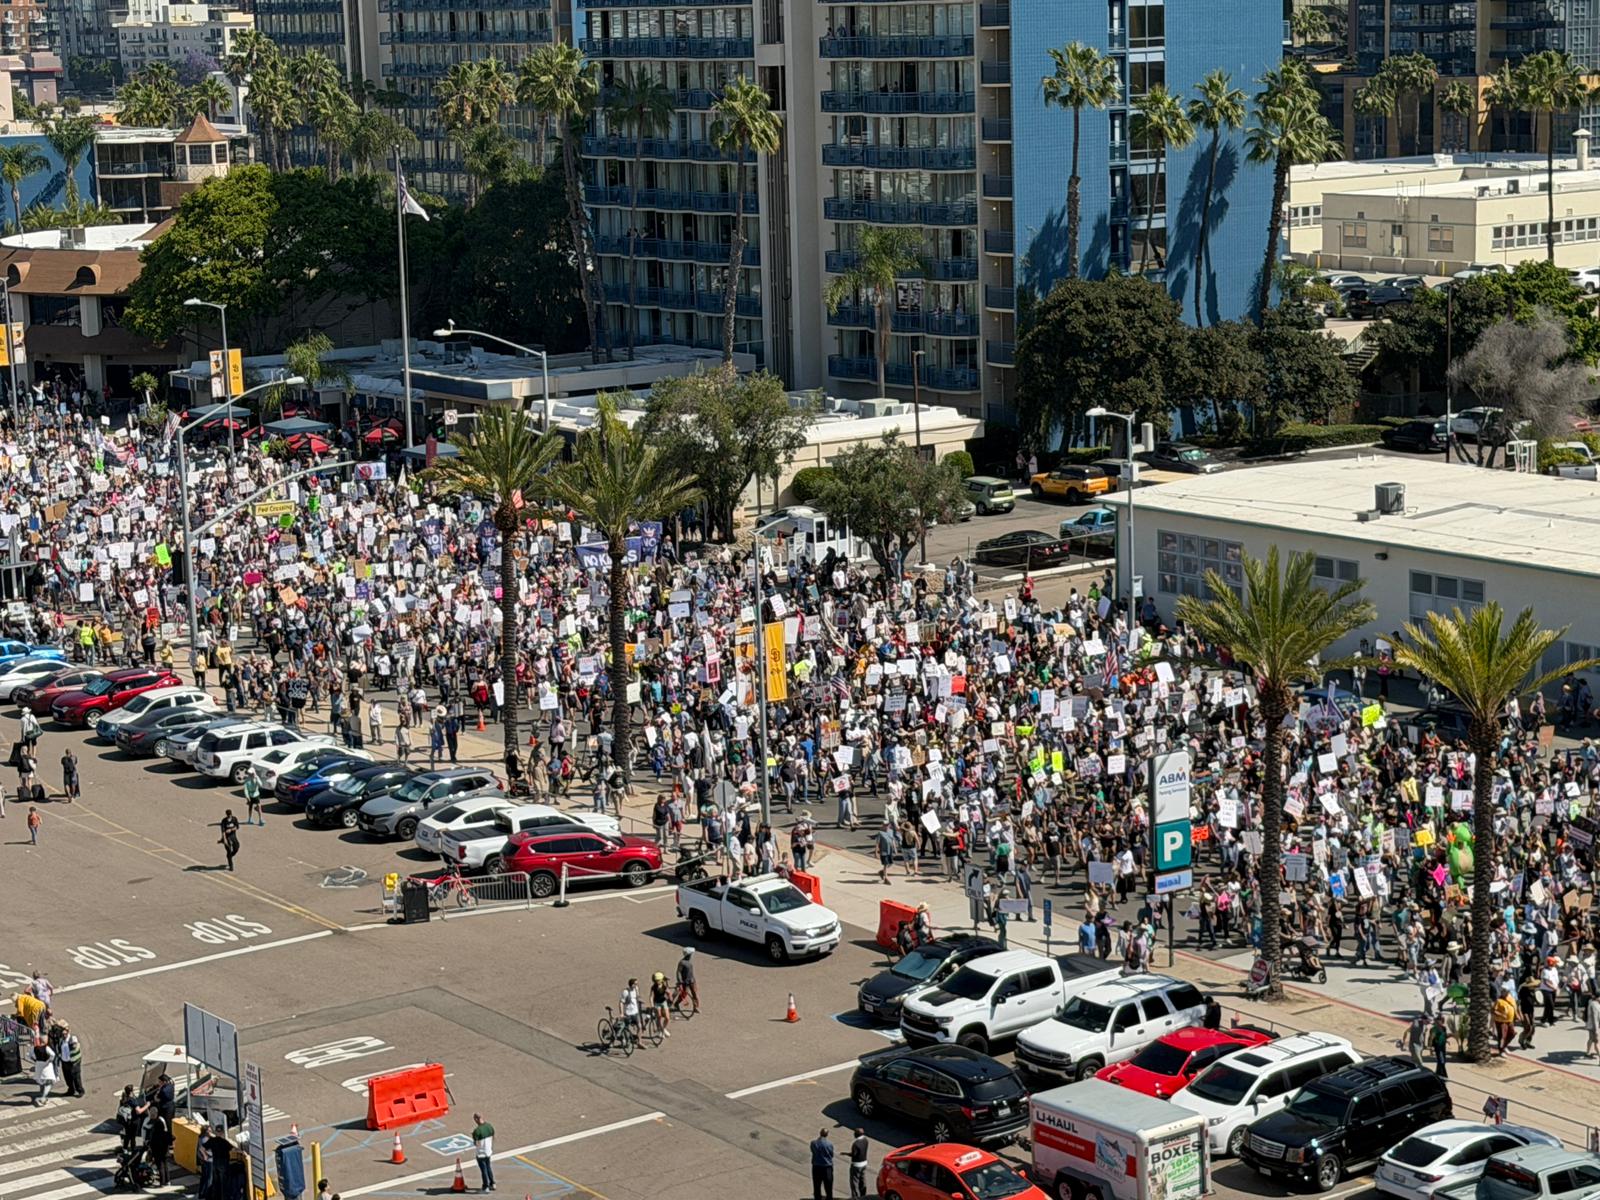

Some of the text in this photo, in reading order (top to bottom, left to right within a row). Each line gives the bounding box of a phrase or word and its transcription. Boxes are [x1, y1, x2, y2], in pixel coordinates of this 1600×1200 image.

[583, 554, 598, 567] NO
[1159, 771, 1187, 786] ABM
[1163, 830, 1183, 862] P
[183, 914, 273, 944] STOP
[739, 919, 759, 930] POLICE
[65, 938, 157, 970] STOP
[1035, 1110, 1079, 1134] U-HAUL
[1151, 1140, 1202, 1164] BOXES
